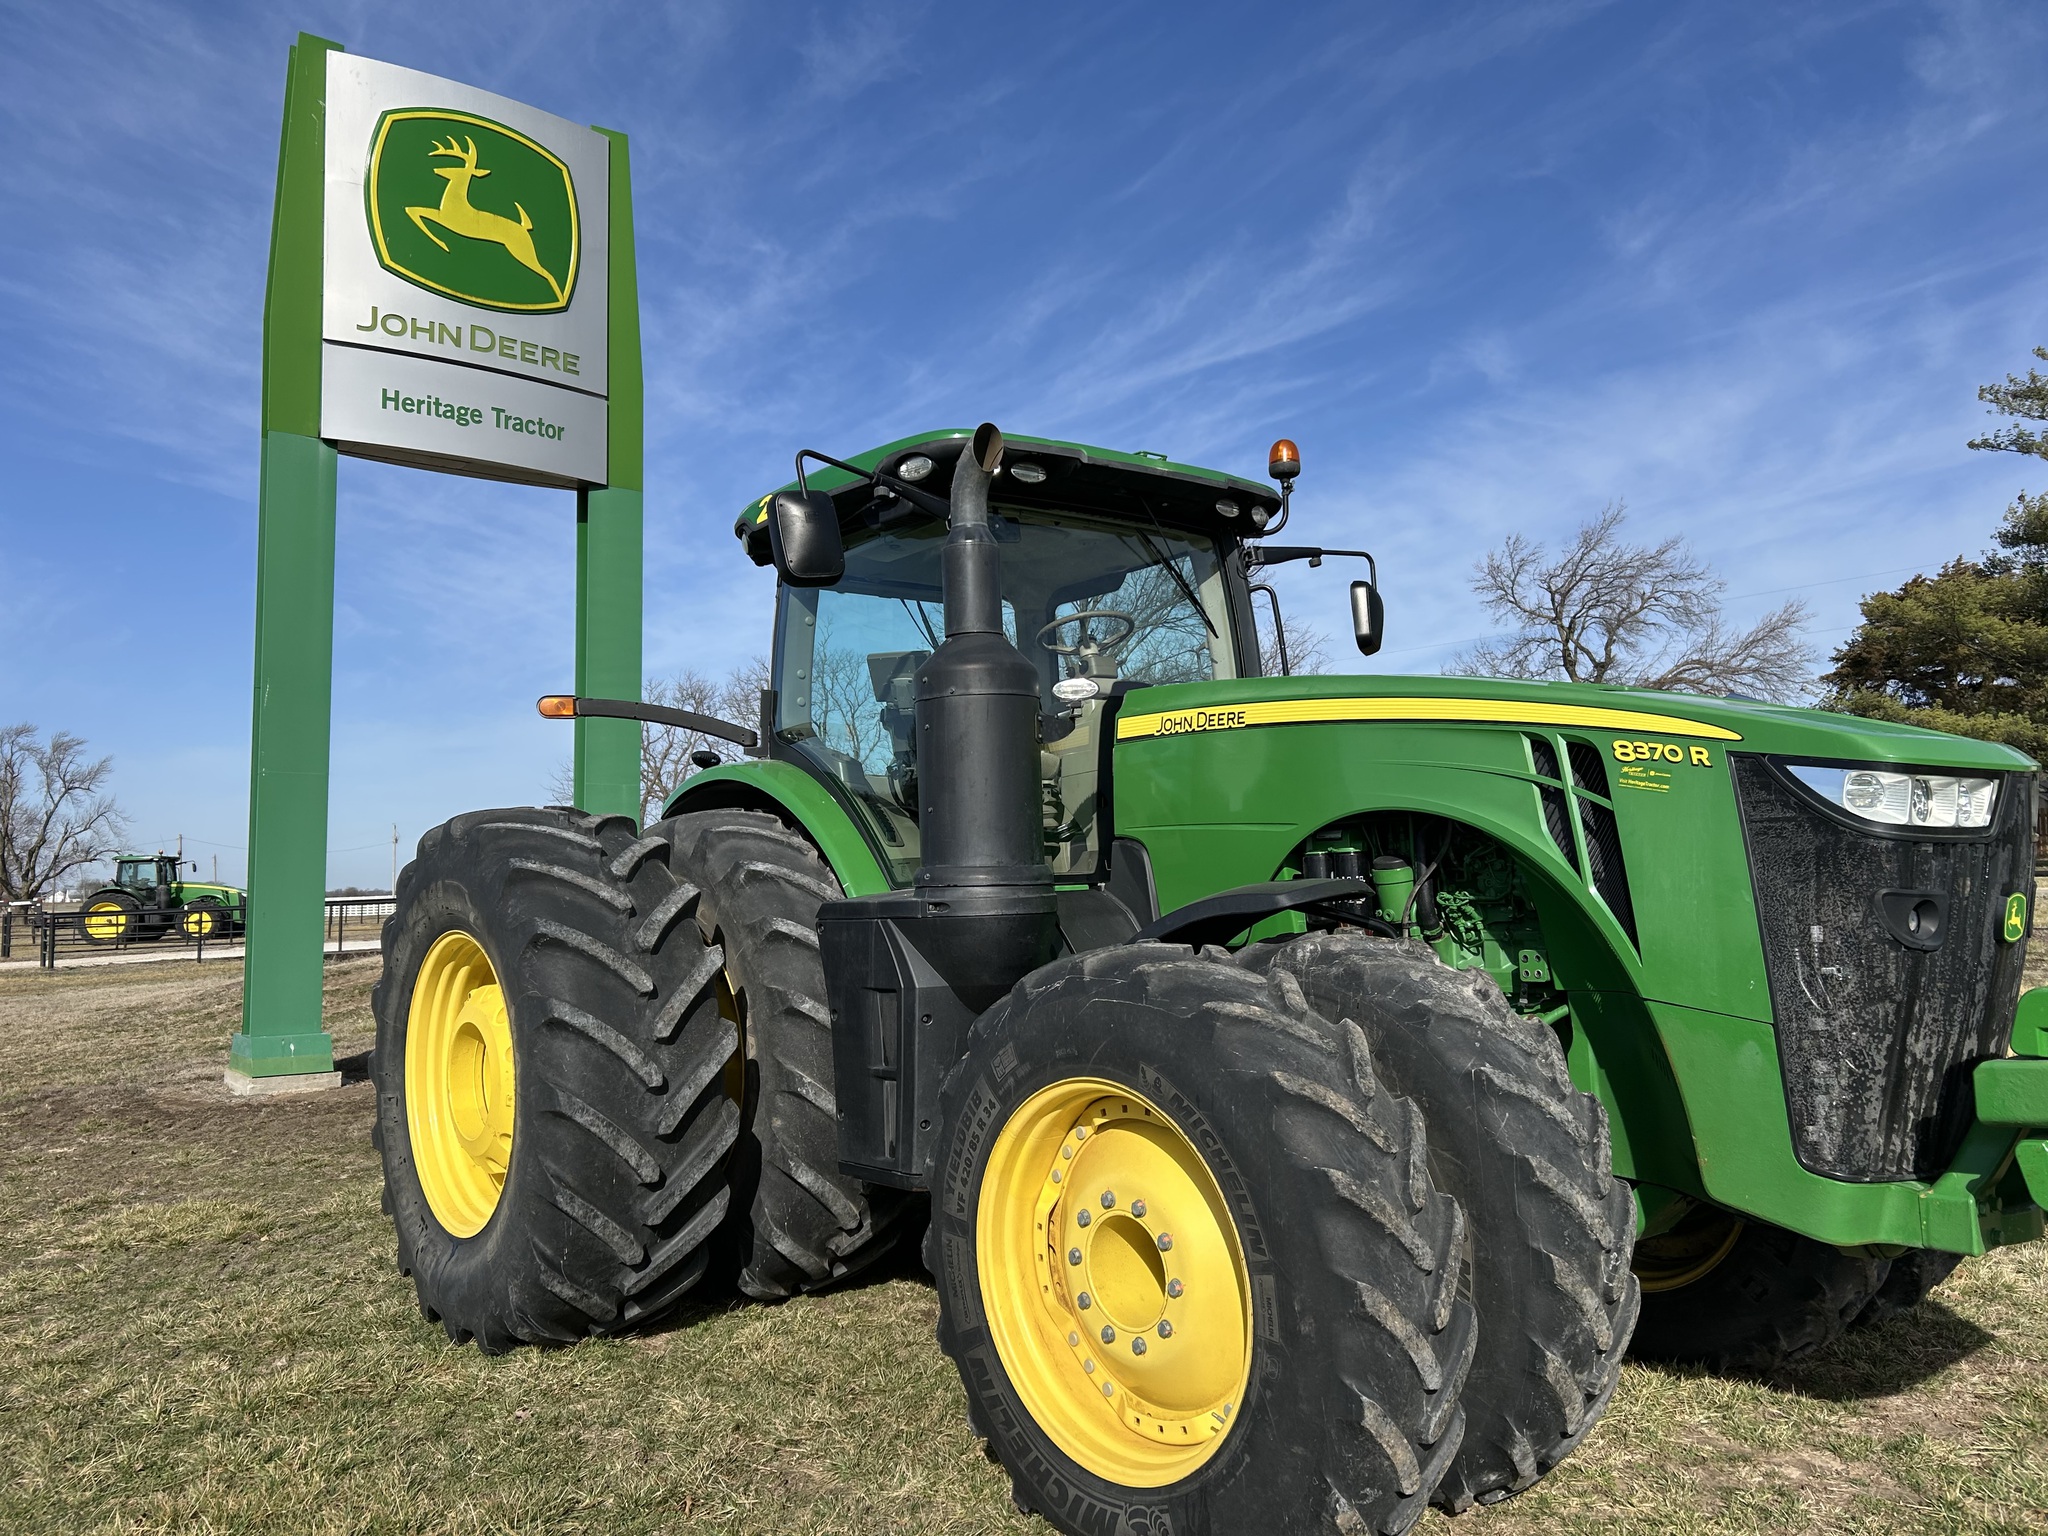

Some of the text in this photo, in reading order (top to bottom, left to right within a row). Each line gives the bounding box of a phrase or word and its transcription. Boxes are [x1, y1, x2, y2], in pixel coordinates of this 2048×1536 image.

[357, 306, 580, 376] JOHN DEERE
[381, 388, 565, 441] Heritage Tractor
[1156, 711, 1246, 733] JOHN DEERE
[1612, 740, 1713, 767] 8370 R
[945, 1090, 983, 1196] YIELDBIB
[956, 1098, 997, 1214] VF 420/85 R 34
[1169, 1092, 1269, 1258] MICHELIN
[945, 1239, 959, 1298] MICHELIN
[1265, 1297, 1275, 1338] MICHELIN
[967, 1357, 1121, 1536] MICHELIN
